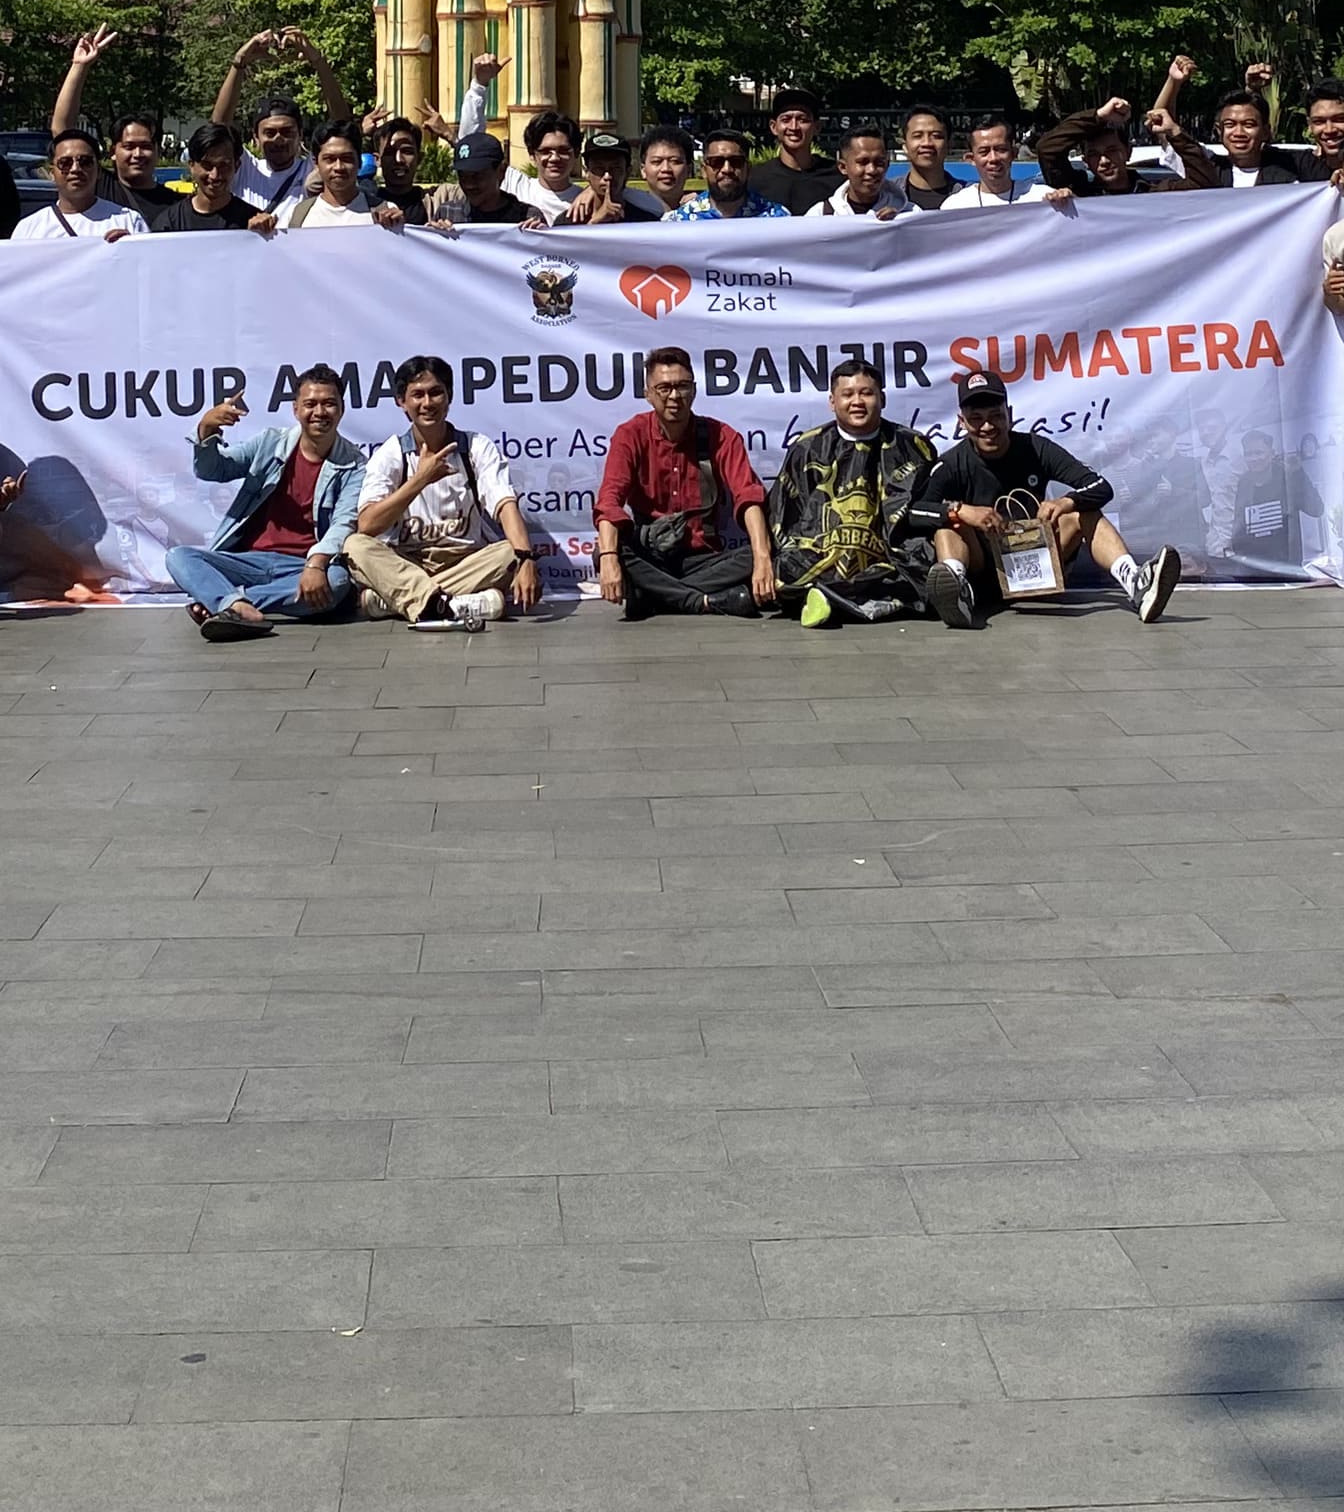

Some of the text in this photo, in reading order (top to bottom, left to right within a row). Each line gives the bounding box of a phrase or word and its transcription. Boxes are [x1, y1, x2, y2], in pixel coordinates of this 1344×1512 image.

[521, 255, 544, 271] WEST
[706, 266, 793, 288] Rumah
[707, 292, 777, 313] Zakat
[31, 366, 250, 421] CUKUR
[268, 360, 402, 413] AMA
[461, 351, 647, 405] PEDUL
[949, 319, 1285, 384] SUMATERA
